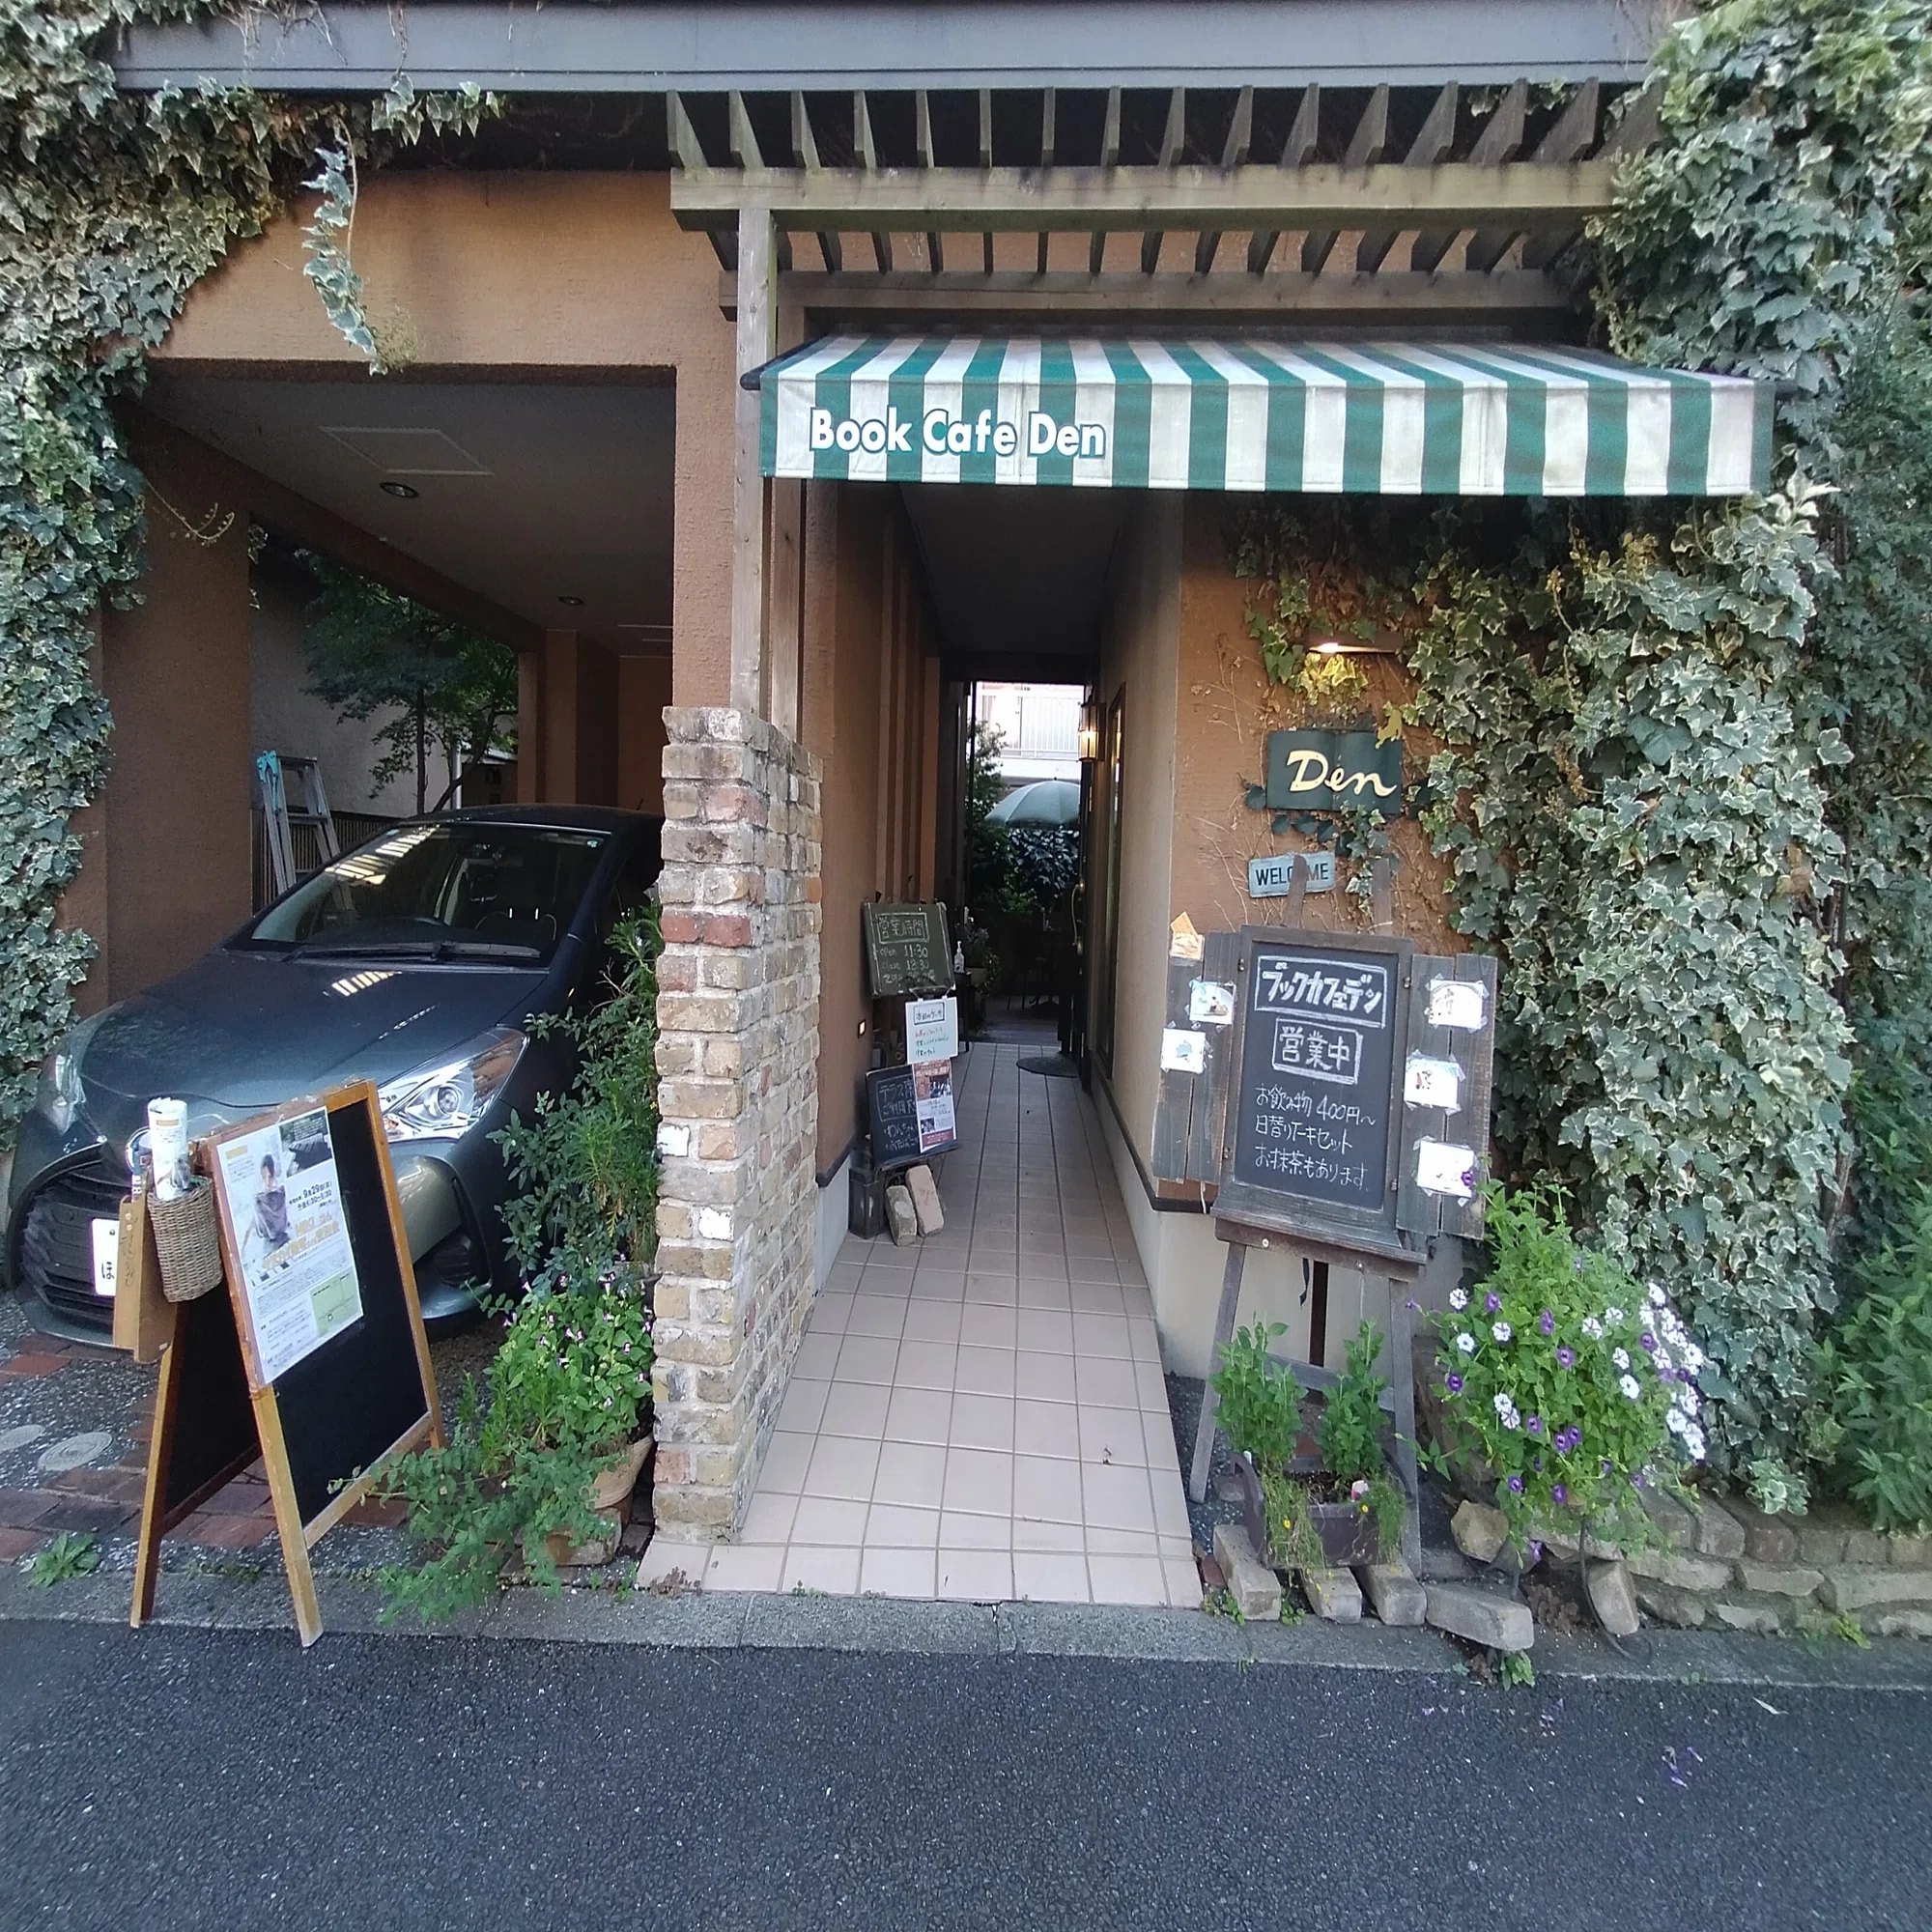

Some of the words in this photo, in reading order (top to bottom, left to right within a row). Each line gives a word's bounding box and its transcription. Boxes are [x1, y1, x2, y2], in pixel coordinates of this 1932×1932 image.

[810, 407, 912, 453] Book
[923, 408, 1017, 456] Cafe
[1028, 412, 1107, 459] Den
[1287, 750, 1398, 797] Den
[1255, 863, 1329, 886] WELCME
[878, 917, 925, 939] 営業時間
[904, 944, 928, 957] 11:30
[1262, 962, 1382, 1013] ブックカフェデン
[1279, 1026, 1350, 1070] 営業中
[1255, 1083, 1313, 1118] お飲み物
[1255, 1114, 1353, 1154] 日替りケーキセット
[101, 1261, 115, 1280] ほ
